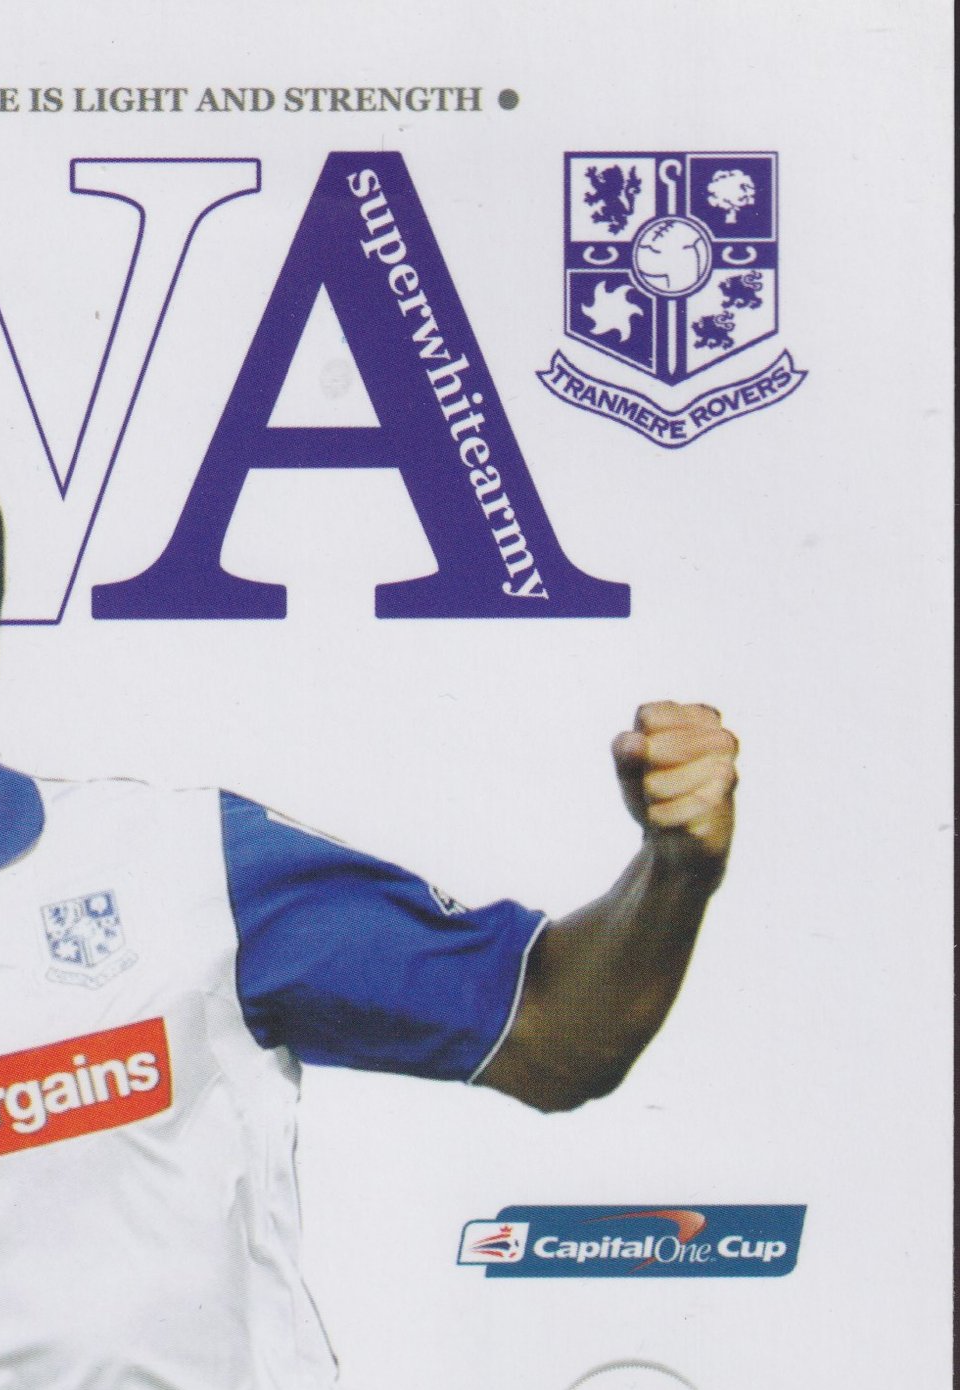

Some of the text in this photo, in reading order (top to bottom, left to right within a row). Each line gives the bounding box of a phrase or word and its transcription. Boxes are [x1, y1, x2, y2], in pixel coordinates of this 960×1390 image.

[30, 87, 63, 112] IS
[74, 87, 188, 112] LIGHT
[195, 88, 275, 112] AND
[284, 87, 482, 112] STRENGTH
[347, 168, 549, 600] superwhitearmy
[550, 364, 794, 439] TRANMERE ROVERS
[717, 1235, 787, 1262] Cup
